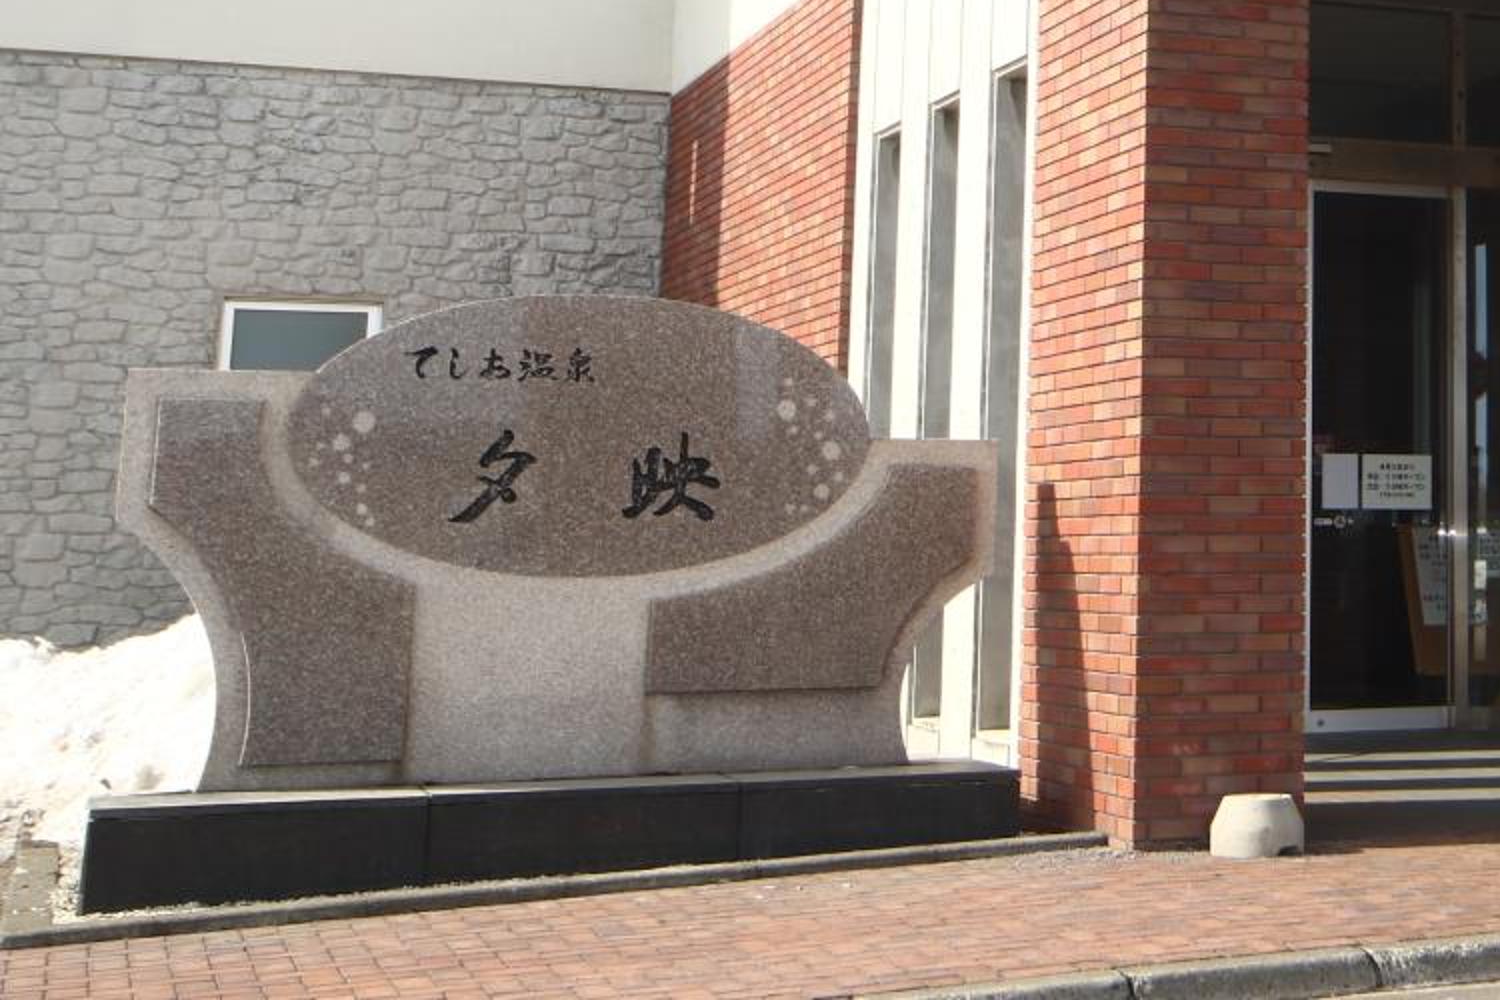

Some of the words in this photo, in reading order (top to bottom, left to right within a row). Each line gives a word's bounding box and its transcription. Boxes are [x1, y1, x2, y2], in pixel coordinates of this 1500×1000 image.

[404, 346, 596, 383] てしお温泉
